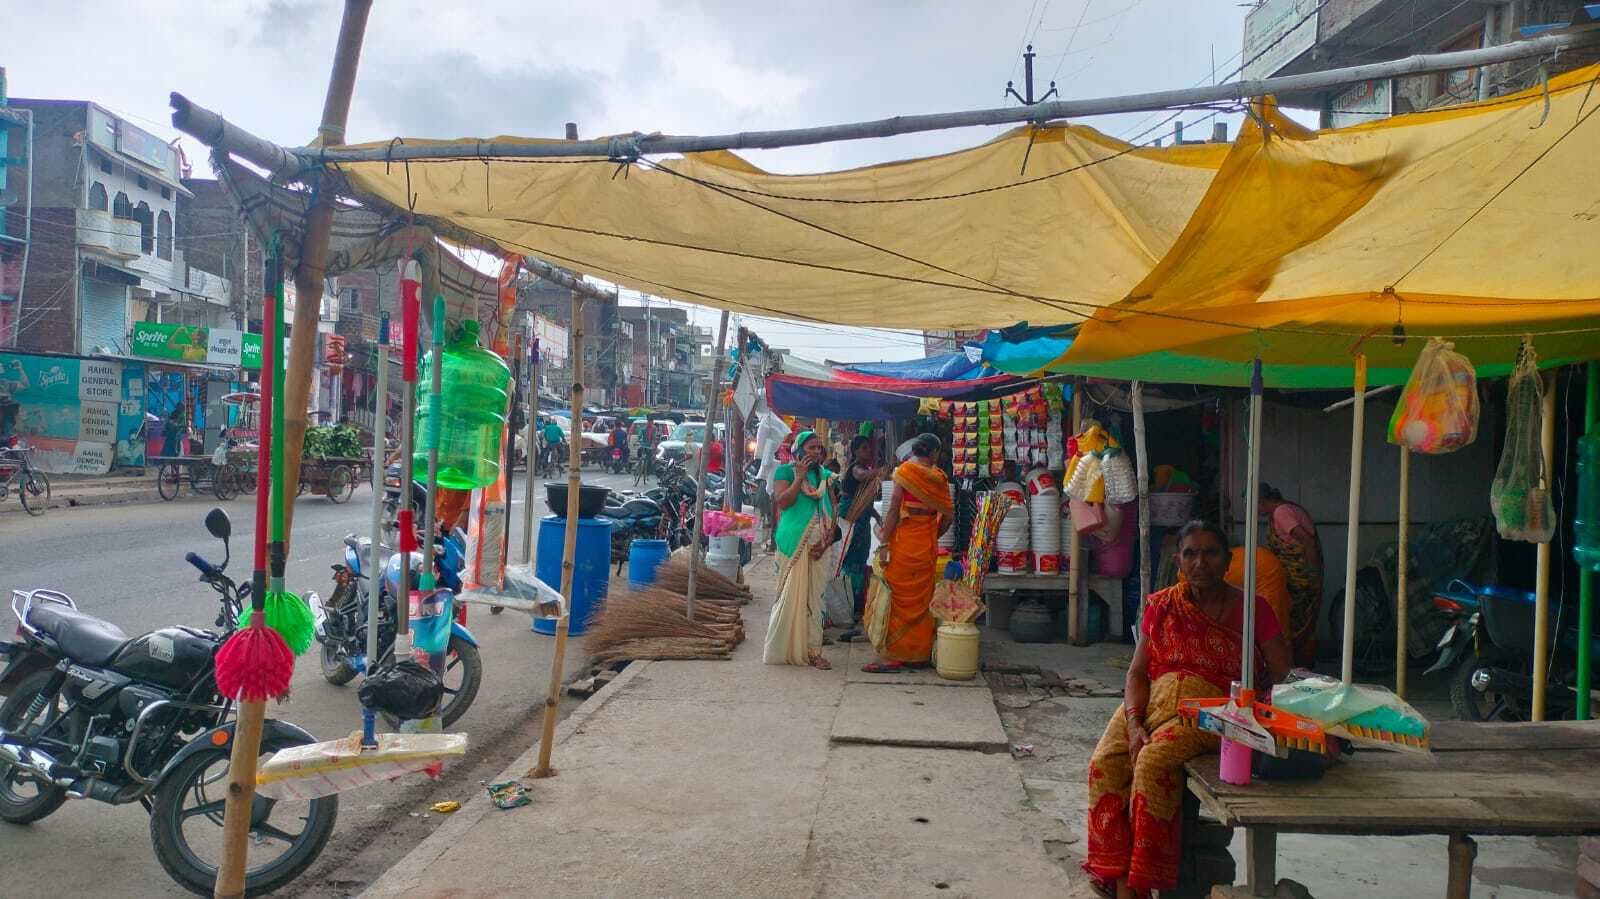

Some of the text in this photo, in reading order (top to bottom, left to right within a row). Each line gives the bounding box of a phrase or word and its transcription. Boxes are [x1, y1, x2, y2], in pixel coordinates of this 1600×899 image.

[136, 331, 167, 343] Sprite
[243, 342, 260, 353] Sprite
[87, 366, 113, 374] RAHUL
[81, 376, 119, 386] GENERAL
[86, 388, 113, 397] STORE
